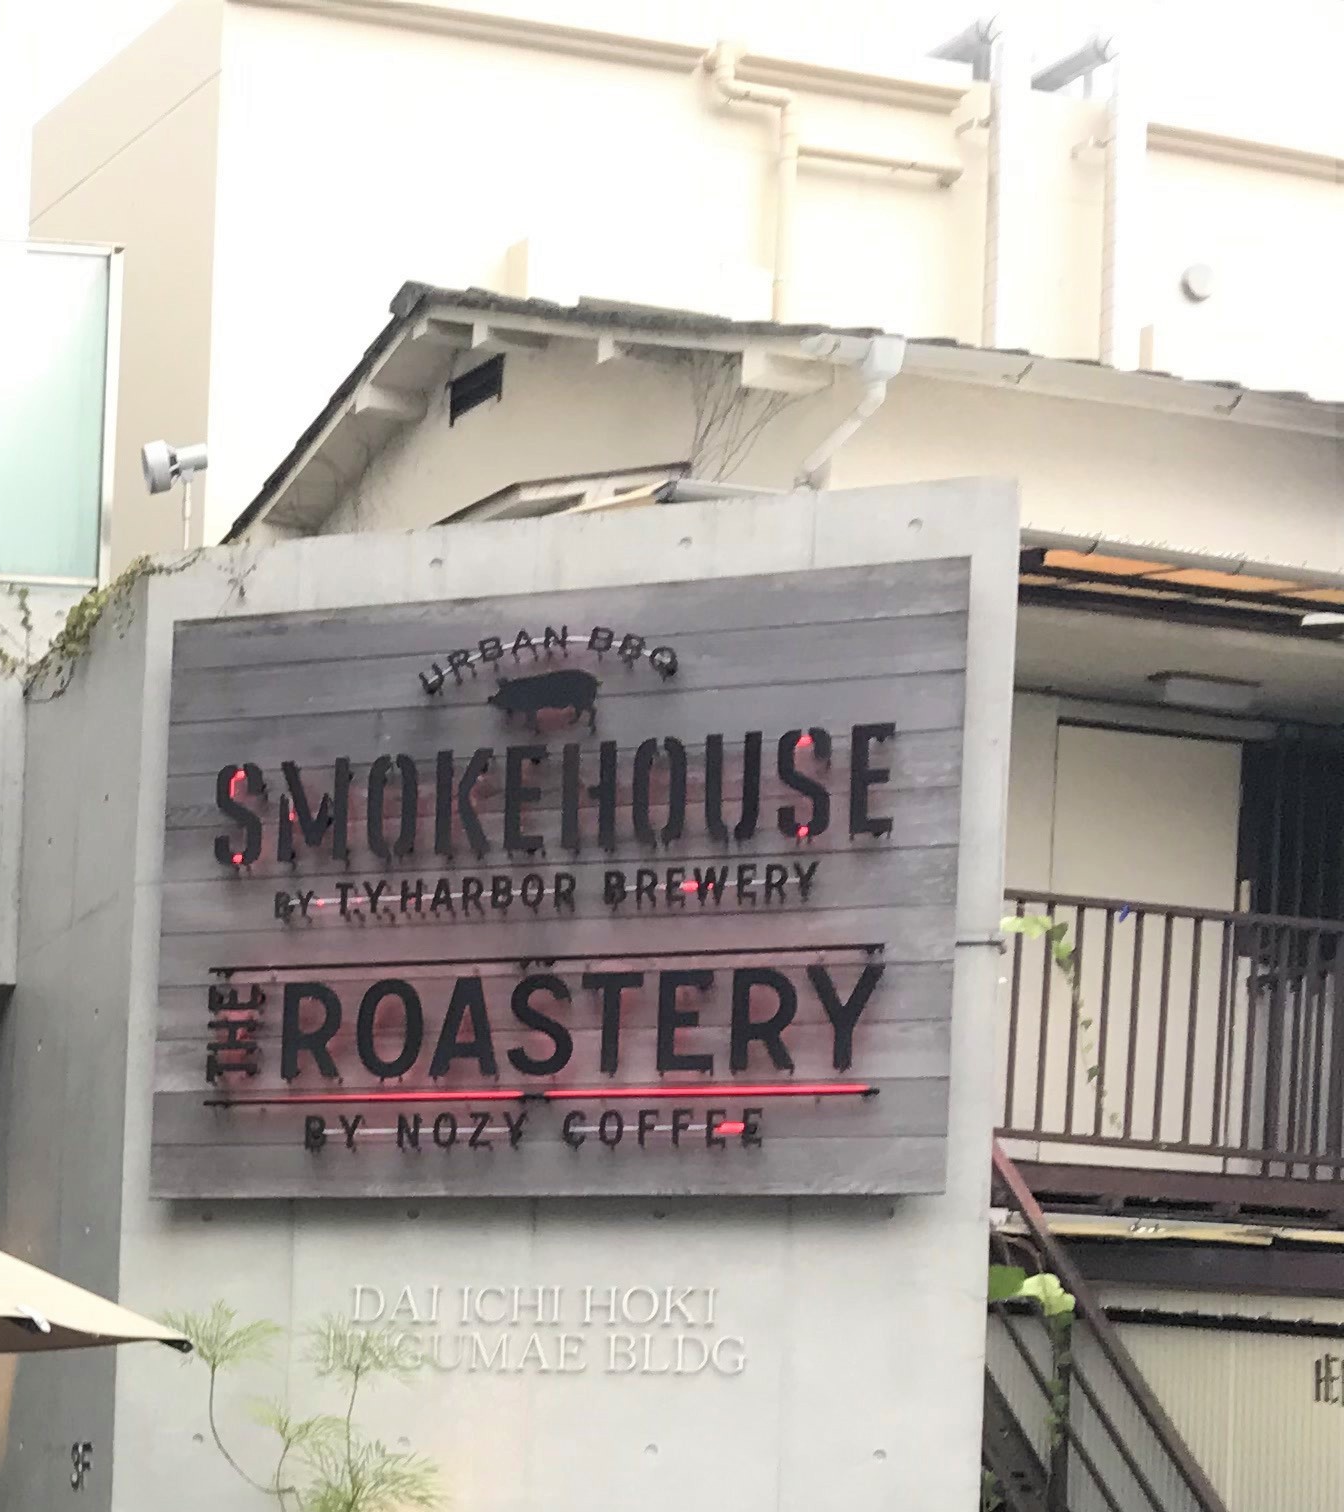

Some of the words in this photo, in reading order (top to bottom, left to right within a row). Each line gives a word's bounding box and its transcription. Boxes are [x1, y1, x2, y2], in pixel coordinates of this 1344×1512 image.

[417, 624, 571, 696] URBAN
[587, 624, 682, 681] BBQ
[213, 721, 897, 869] SMOKEHOUSE
[274, 889, 313, 921] BY
[603, 861, 820, 906] BREWERY
[206, 982, 266, 1083] THE
[280, 963, 886, 1081] ROASTERY
[303, 1111, 365, 1152] BY
[396, 1110, 528, 1150] NOZY
[562, 1107, 766, 1151] COFFEE
[350, 1283, 440, 1325] DAI
[459, 1284, 563, 1326] ICHI
[581, 1285, 719, 1328] HOKI
[604, 1333, 749, 1377] BLDG
